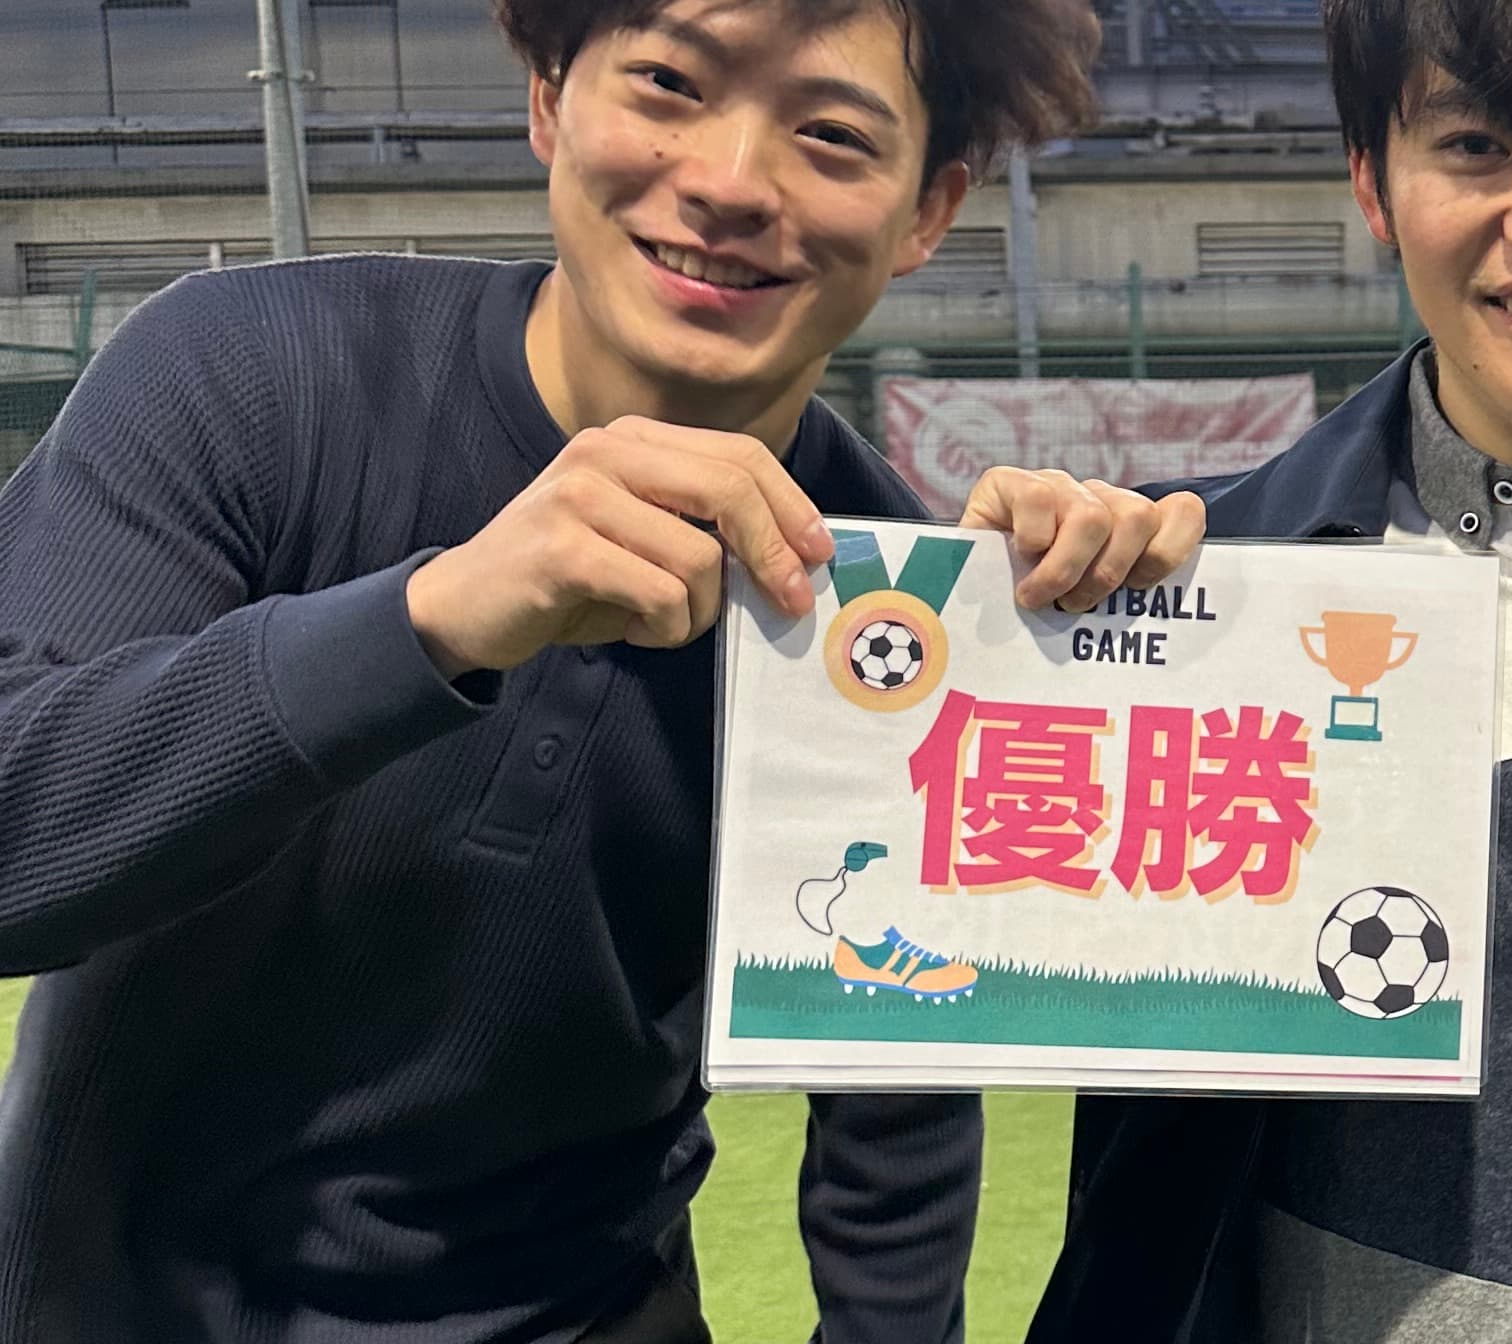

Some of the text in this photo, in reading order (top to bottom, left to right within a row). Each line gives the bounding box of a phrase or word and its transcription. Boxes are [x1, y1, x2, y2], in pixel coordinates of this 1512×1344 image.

[1053, 585, 1217, 621] TBALL
[1072, 627, 1168, 666] GAME
[908, 689, 1317, 903] 優勝
